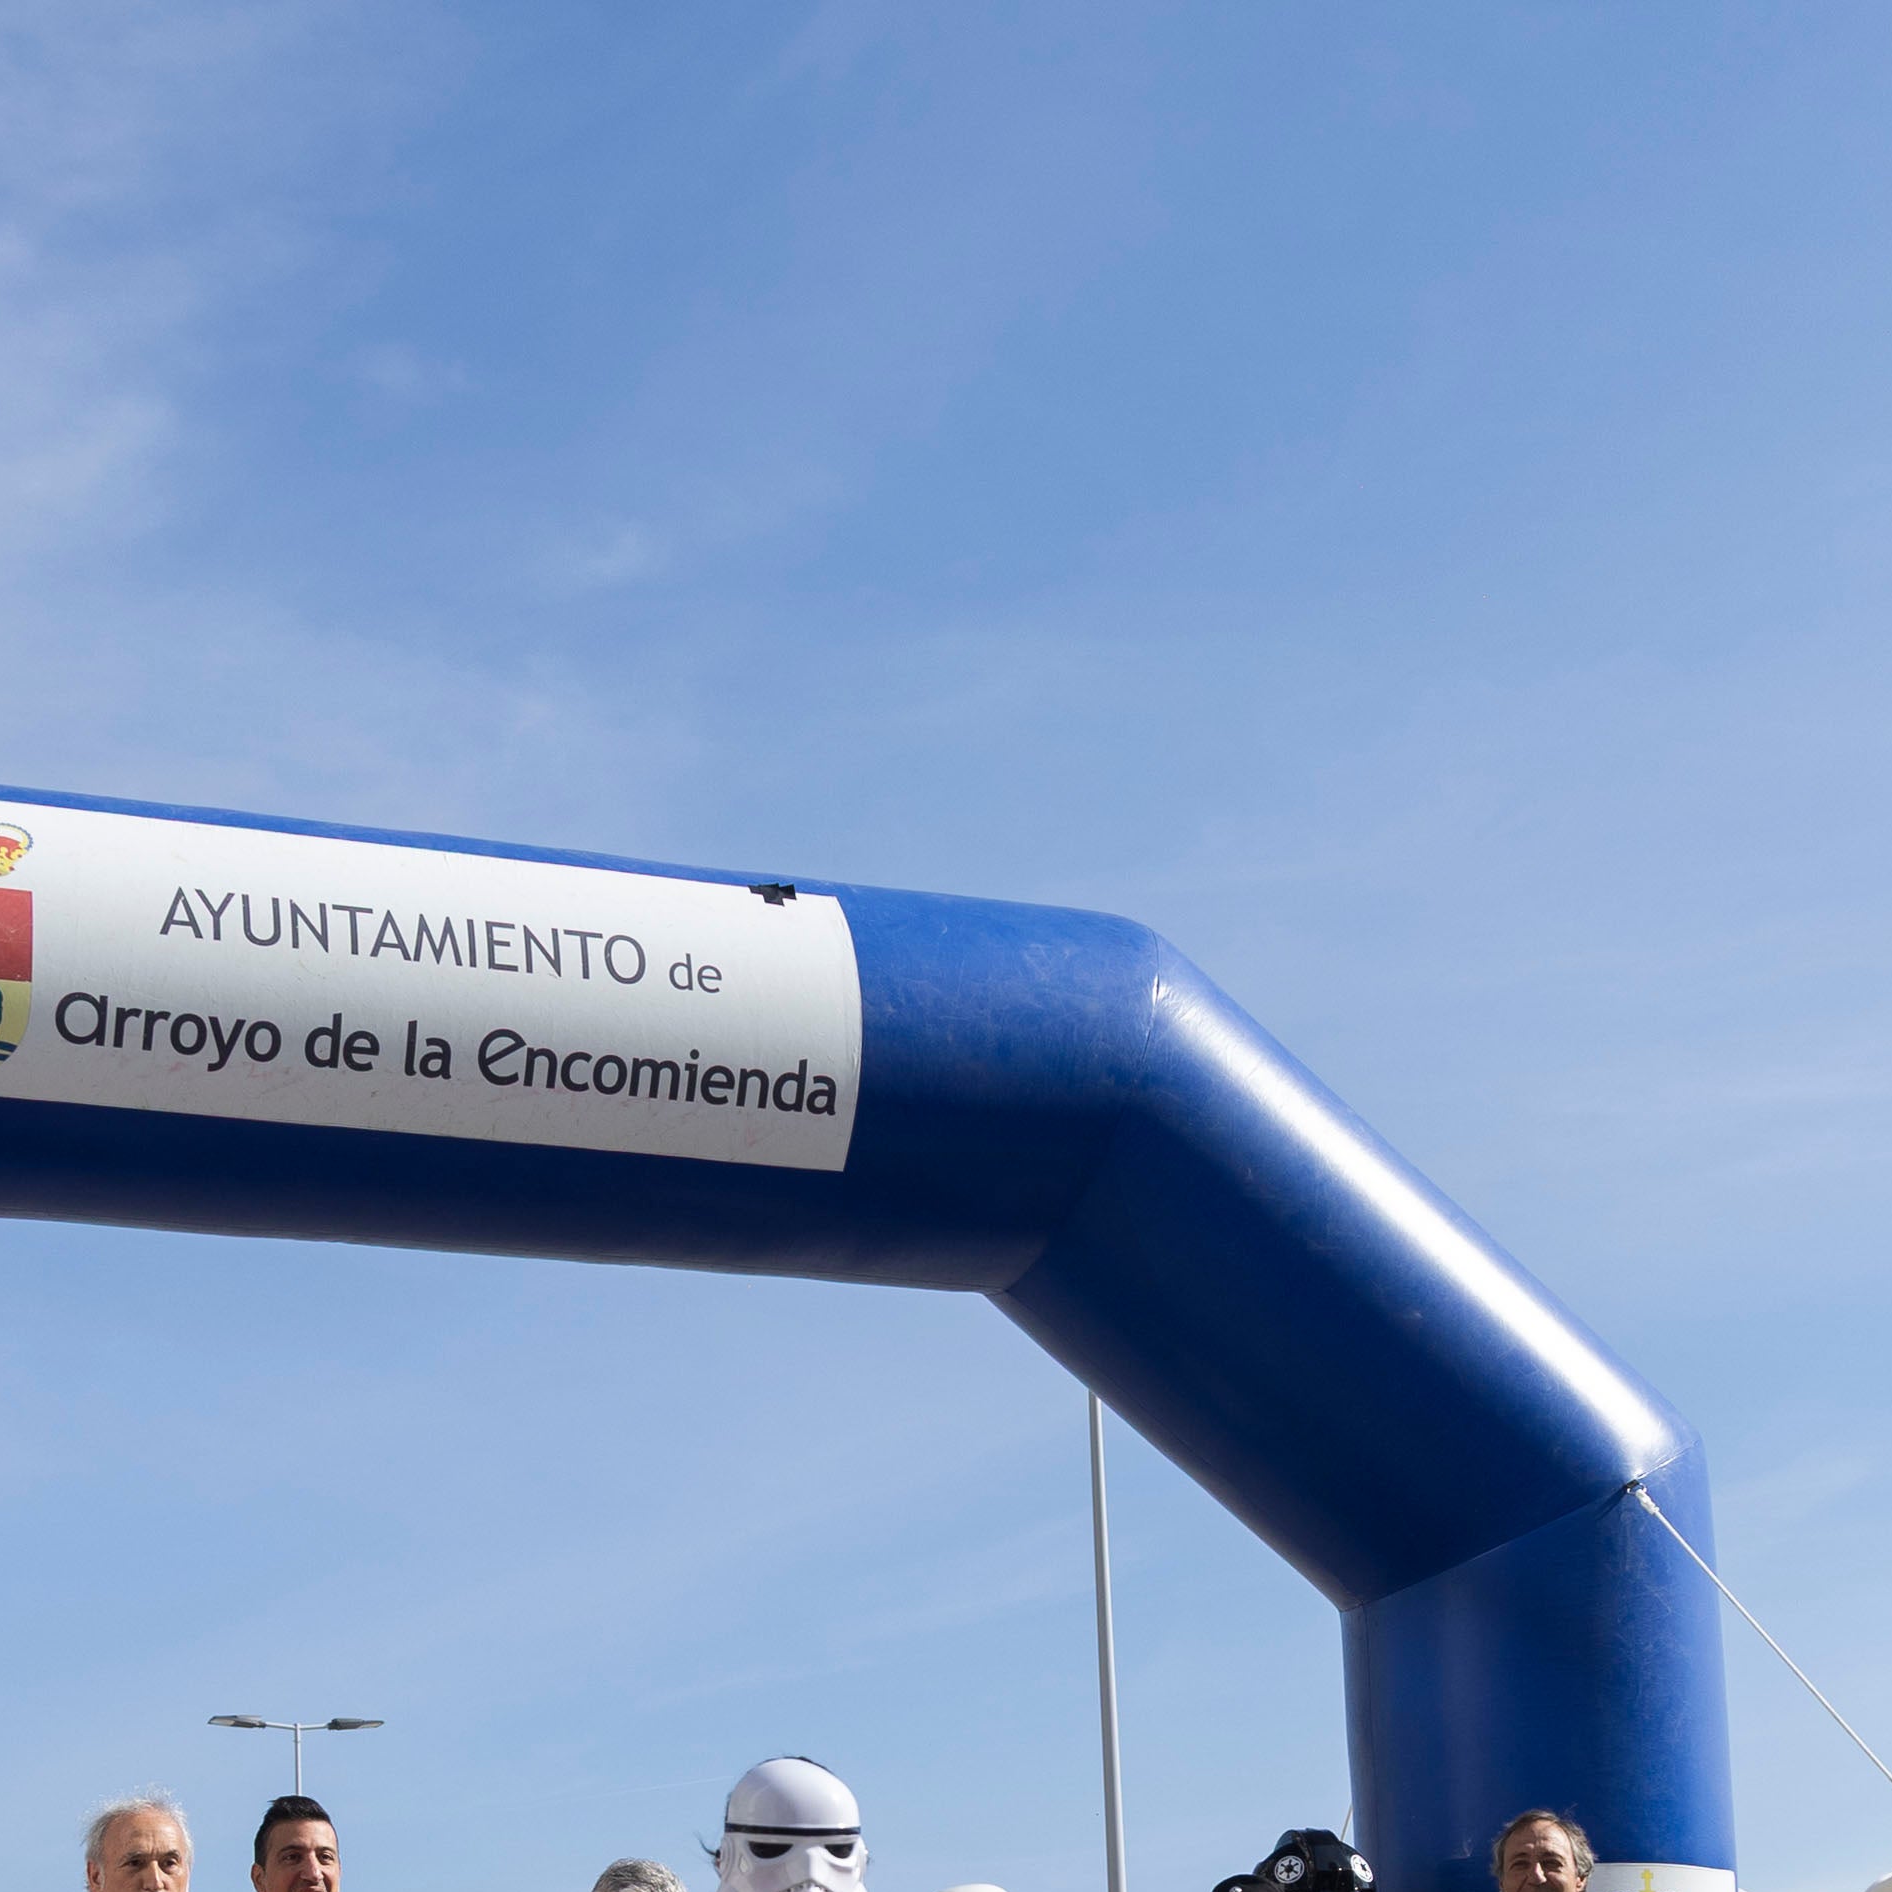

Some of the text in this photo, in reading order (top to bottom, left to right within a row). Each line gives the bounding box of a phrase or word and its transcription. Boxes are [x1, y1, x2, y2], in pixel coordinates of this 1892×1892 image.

[160, 886, 724, 995] AYUNTAMIENTO de
[304, 1011, 379, 1073] de
[405, 1020, 453, 1081] la
